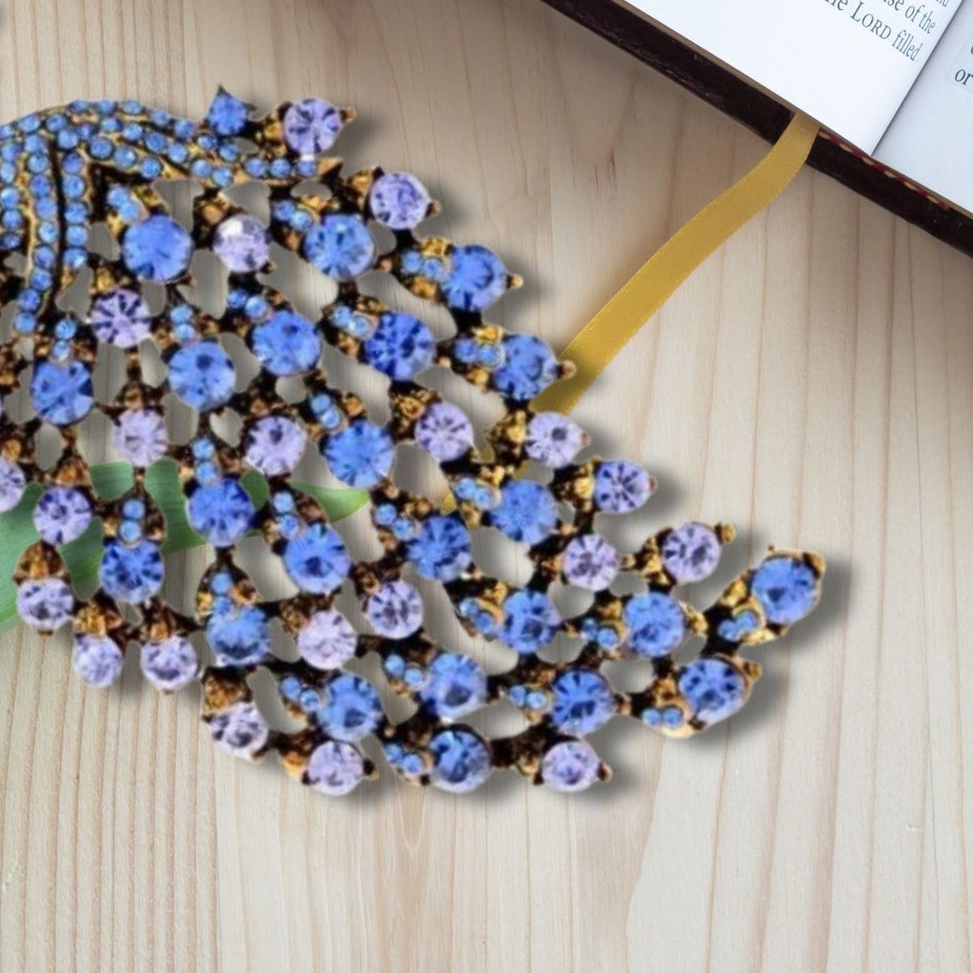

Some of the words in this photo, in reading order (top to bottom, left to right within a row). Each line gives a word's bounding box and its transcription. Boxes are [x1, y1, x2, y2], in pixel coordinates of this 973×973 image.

[904, 4, 926, 23] of
[918, 10, 935, 34] the
[891, 29, 923, 61] filled
